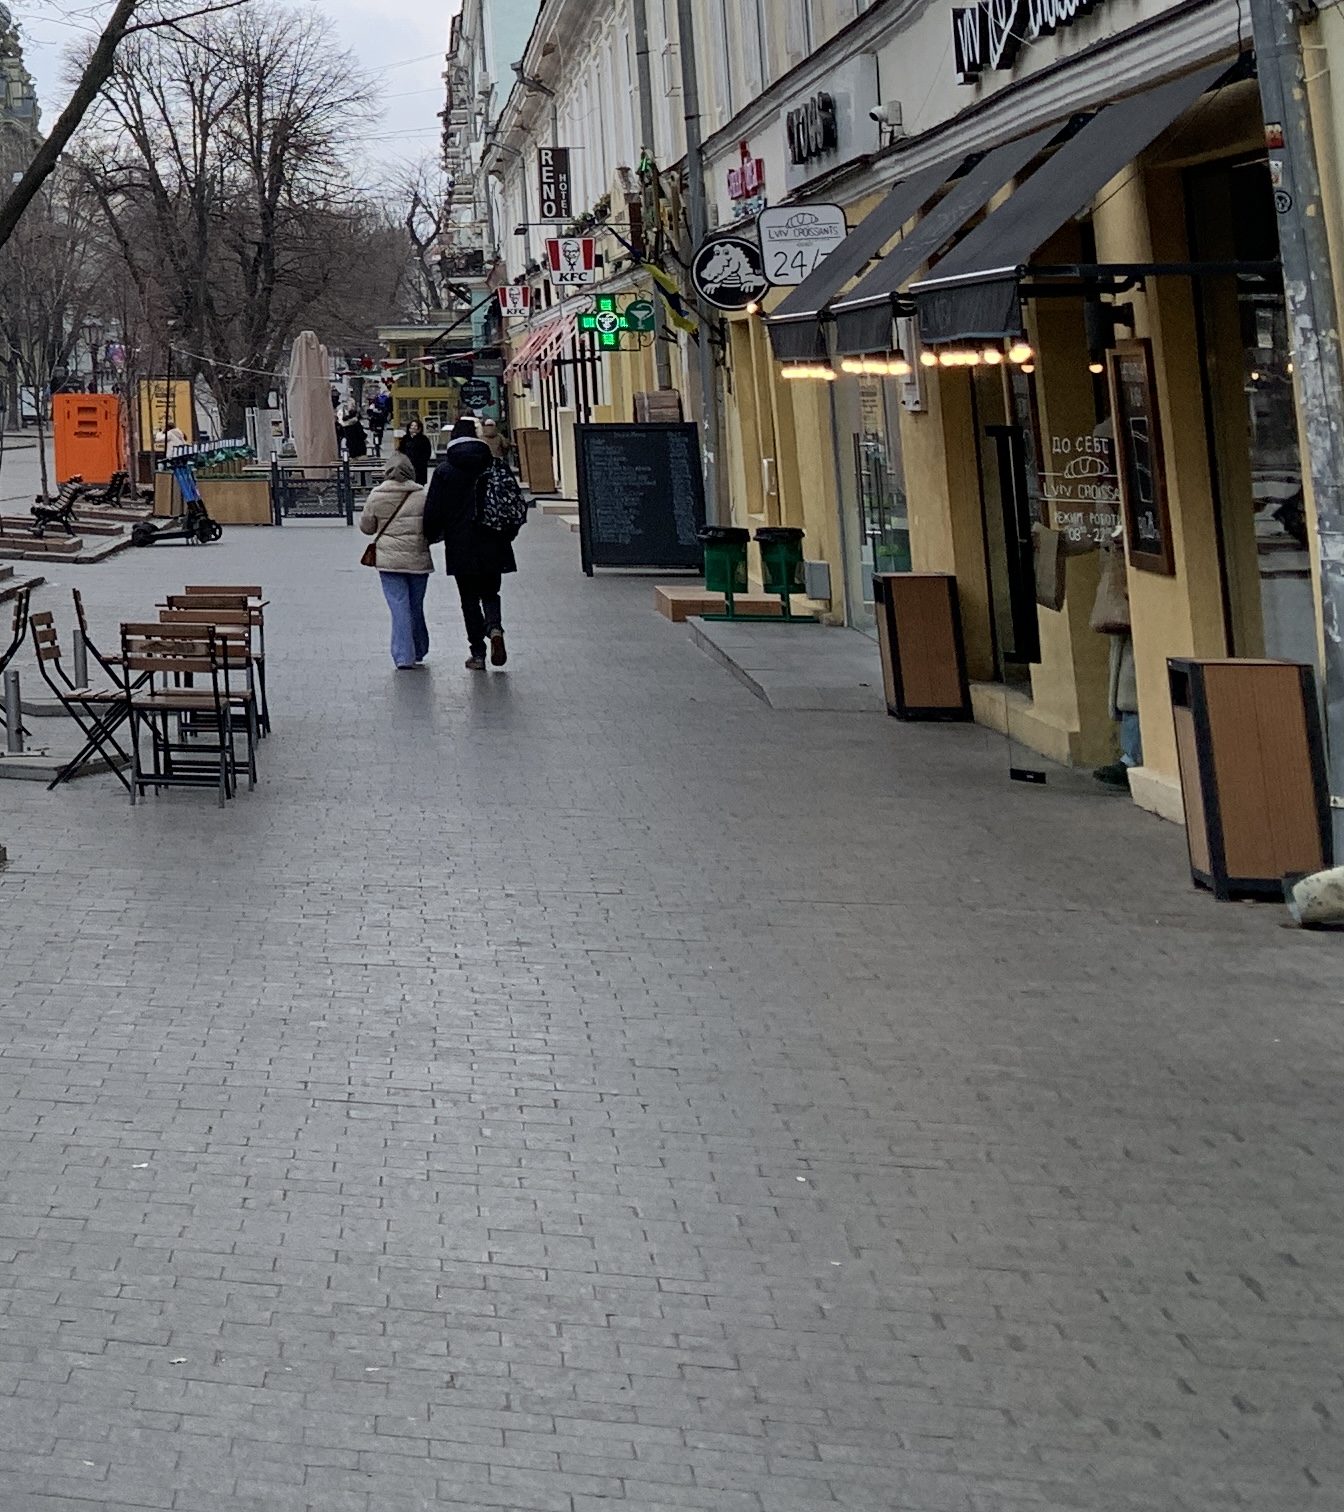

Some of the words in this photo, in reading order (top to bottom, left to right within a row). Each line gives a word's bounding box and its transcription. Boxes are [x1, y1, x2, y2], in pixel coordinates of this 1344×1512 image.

[540, 149, 557, 218] RENO
[558, 173, 568, 218] HOTEL
[793, 225, 840, 238] CROISSANTS
[558, 272, 588, 282] KFC
[1052, 437, 1070, 454] ДО
[1078, 484, 1121, 500] CROISSA
